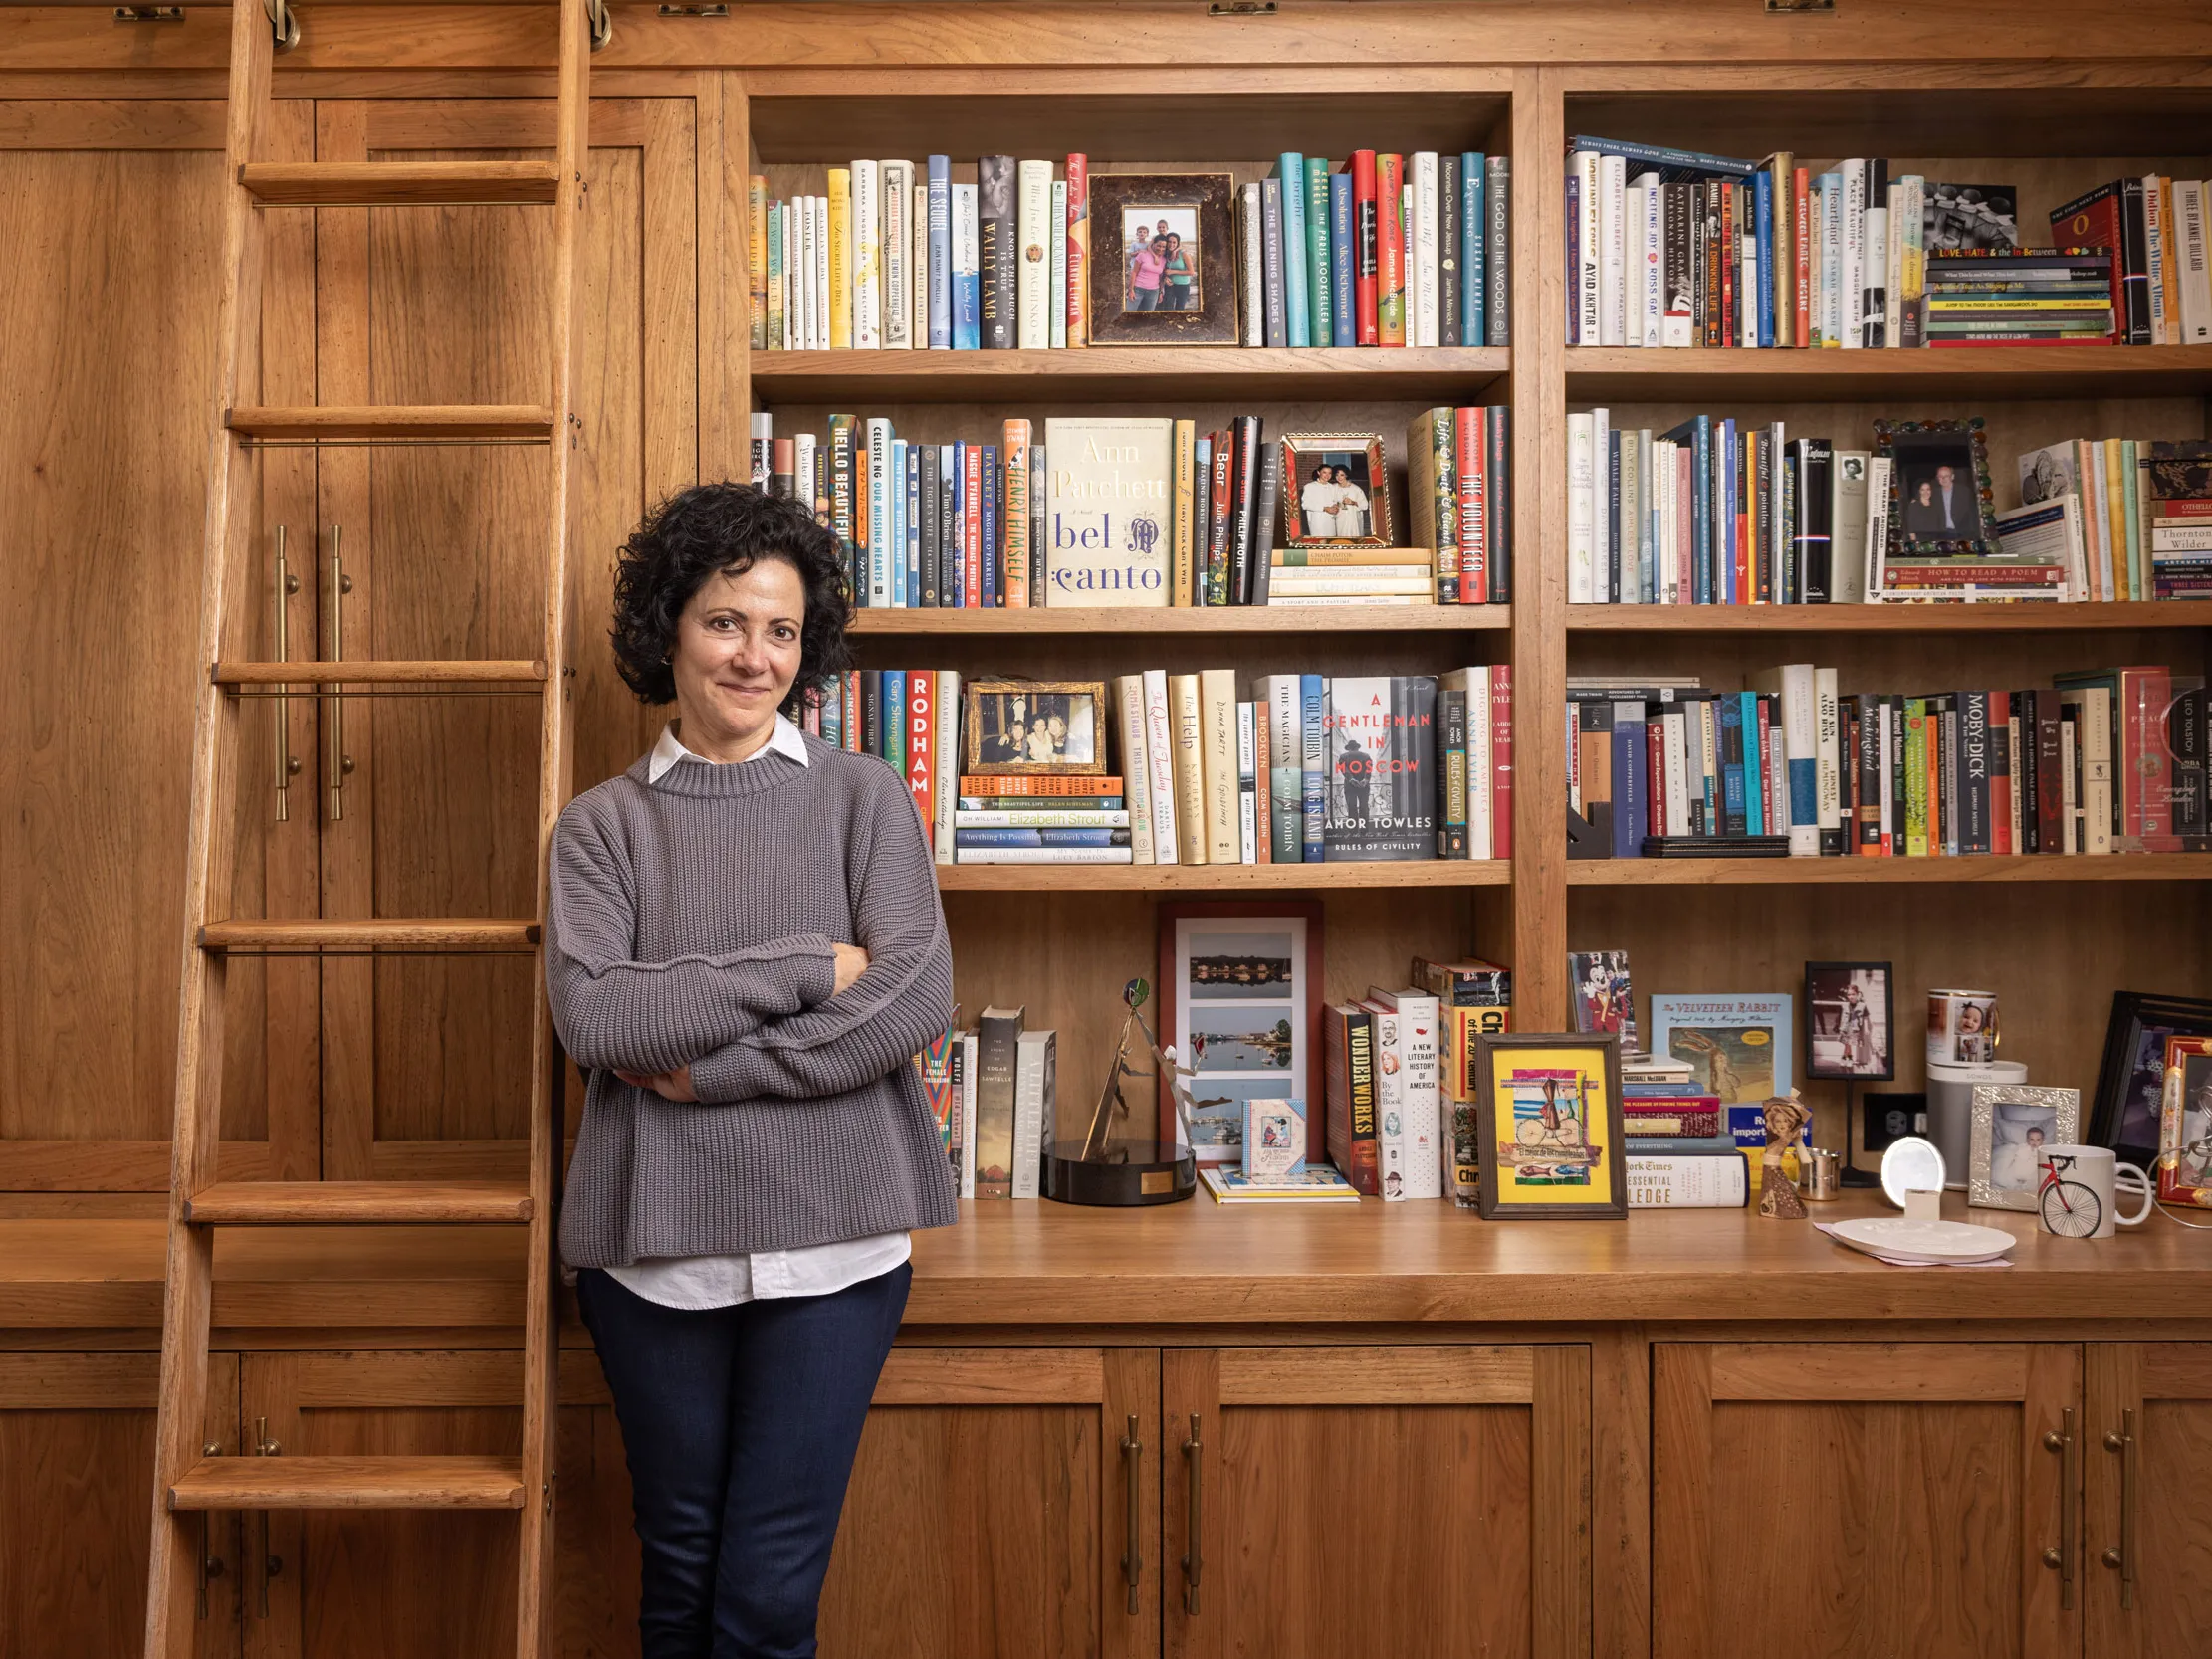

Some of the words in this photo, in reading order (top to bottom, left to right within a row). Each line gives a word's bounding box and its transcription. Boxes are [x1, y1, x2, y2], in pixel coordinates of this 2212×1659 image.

[931, 177, 947, 194] THE
[1710, 183, 1720, 207] HAMILL
[1338, 185, 1347, 234] Absolution
[2147, 189, 2158, 226] Didion
[2186, 190, 2198, 211] THREE
[931, 199, 947, 232] SEQUEL
[1495, 202, 1504, 229] GOD
[1830, 188, 1840, 245] Heartland
[2187, 213, 2199, 222] BY
[1495, 233, 1504, 246] OF
[2150, 227, 2160, 249] The
[2188, 223, 2201, 241] ANNIE
[984, 222, 996, 272] WALLY
[1000, 252, 1007, 261] IS
[1495, 251, 1504, 264] THE
[2189, 243, 2203, 271] DILLARD
[1585, 263, 1596, 289] AYAD
[1709, 251, 1718, 292] DRINKING
[2150, 248, 2161, 280] White
[984, 279, 996, 319] LAMB
[1270, 283, 1280, 323] SHADES
[1320, 262, 1329, 323] BOOKSELLER
[1389, 279, 1398, 316] McBride
[1494, 268, 1504, 314] WOODS
[2152, 282, 2163, 318] Album
[1585, 292, 1596, 325] AKHTAR
[1495, 414, 1504, 438] Lucky
[1082, 434, 1141, 463] Ann
[1495, 441, 1504, 461] Dogs
[1701, 423, 1710, 480] CANOPY
[874, 465, 883, 478] NG
[1052, 469, 1167, 499] Patchett
[1216, 453, 1228, 486] Bear
[874, 482, 883, 501] OUR
[1462, 473, 1481, 496] THE
[943, 493, 952, 509] Tim
[1216, 501, 1225, 524] Julia
[874, 505, 883, 543] MISSING
[943, 511, 953, 540] O'Brien
[1053, 513, 1113, 549] bel
[1237, 510, 1247, 540] PHILIP
[1461, 502, 1483, 572] VOLUNTEER
[2162, 529, 2212, 538] Thornton
[1007, 519, 1026, 583] HIMSELF
[1214, 526, 1224, 561] Phillips
[1236, 542, 1246, 568] ROTH
[2171, 539, 2206, 548] Wilder
[1052, 565, 1162, 593] canto
[1371, 694, 1381, 706] A
[912, 678, 929, 793] RODHAM
[1180, 715, 1198, 750] Help
[1322, 714, 1431, 728] GENTLEMAN
[1281, 711, 1290, 763] MAGICIAN
[1368, 736, 1385, 748] IN
[1860, 706, 1874, 771] Mockingbird
[1894, 736, 1903, 764] Malamud
[1968, 694, 1984, 778] MOBY-DICK
[1133, 747, 1142, 765] THIS
[1335, 759, 1420, 773] MOSCOW
[1134, 767, 1143, 785] TIME
[1469, 753, 1478, 792] TYLER
[1307, 777, 1321, 802] LONG
[1008, 810, 1066, 825] Elizabeth
[1068, 810, 1106, 825] Strout
[1136, 787, 1146, 831] TOMORROW
[1307, 805, 1321, 839] ISLAND
[1325, 817, 1366, 829] AMOR
[1370, 817, 1432, 829] TOWLES
[1029, 1058, 1042, 1067] A
[1351, 1025, 1373, 1134] WONDERWORKS
[1027, 1073, 1041, 1129] LITTLE
[1026, 1134, 1040, 1168] LIFE
[1627, 1176, 1670, 1186] ESSENTIAL
